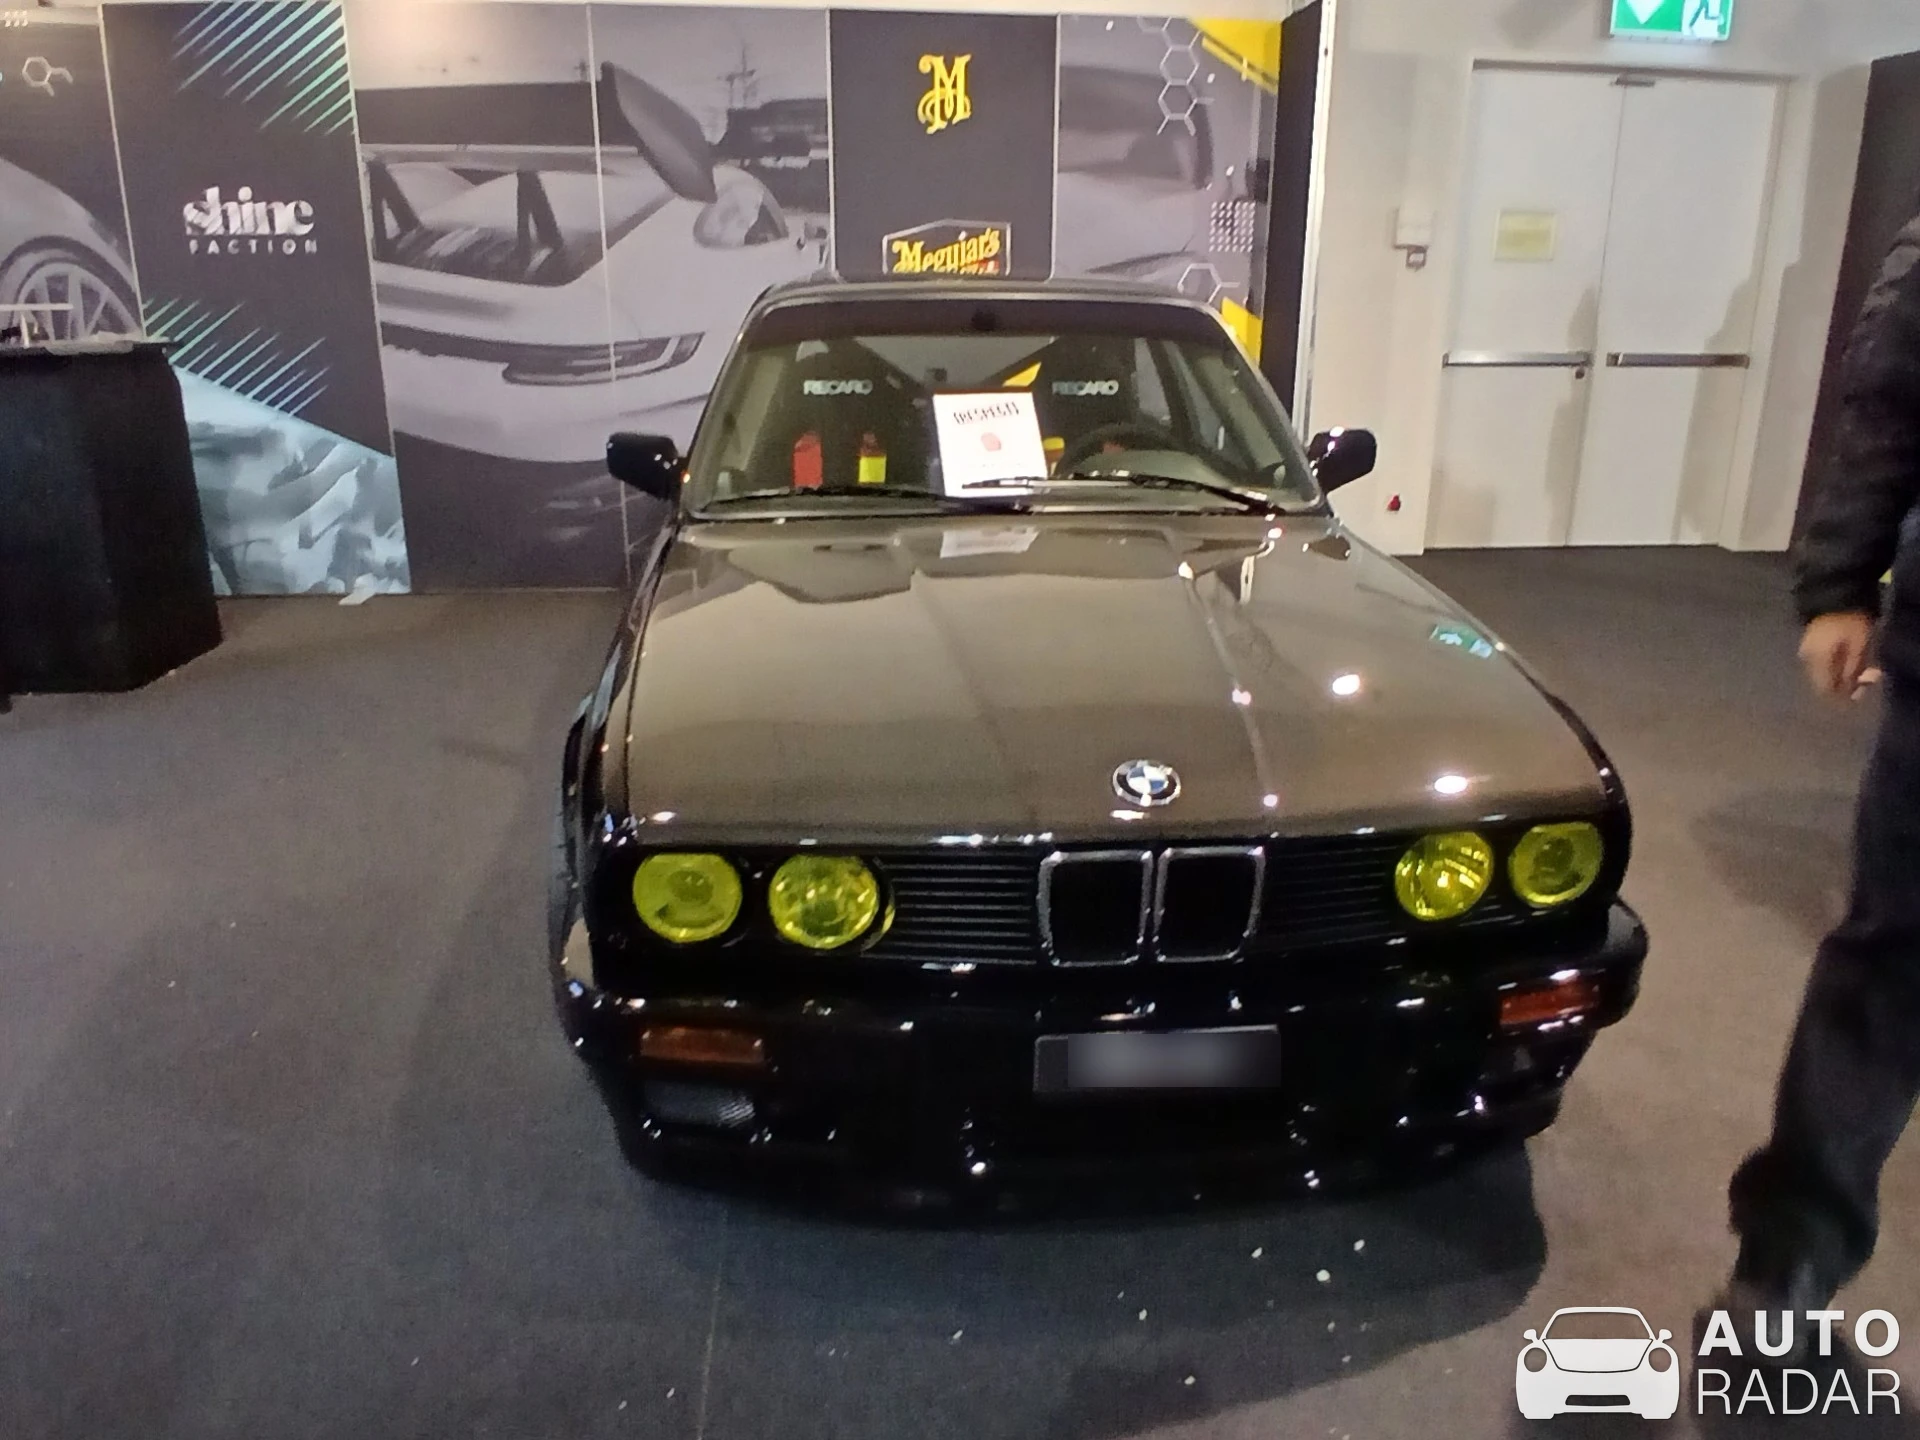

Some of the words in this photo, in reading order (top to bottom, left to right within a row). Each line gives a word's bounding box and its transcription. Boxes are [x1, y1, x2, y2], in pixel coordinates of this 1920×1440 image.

[917, 53, 972, 135] M
[183, 185, 315, 236] shine
[803, 379, 873, 396] RECARO
[1052, 379, 1120, 396] RECARO
